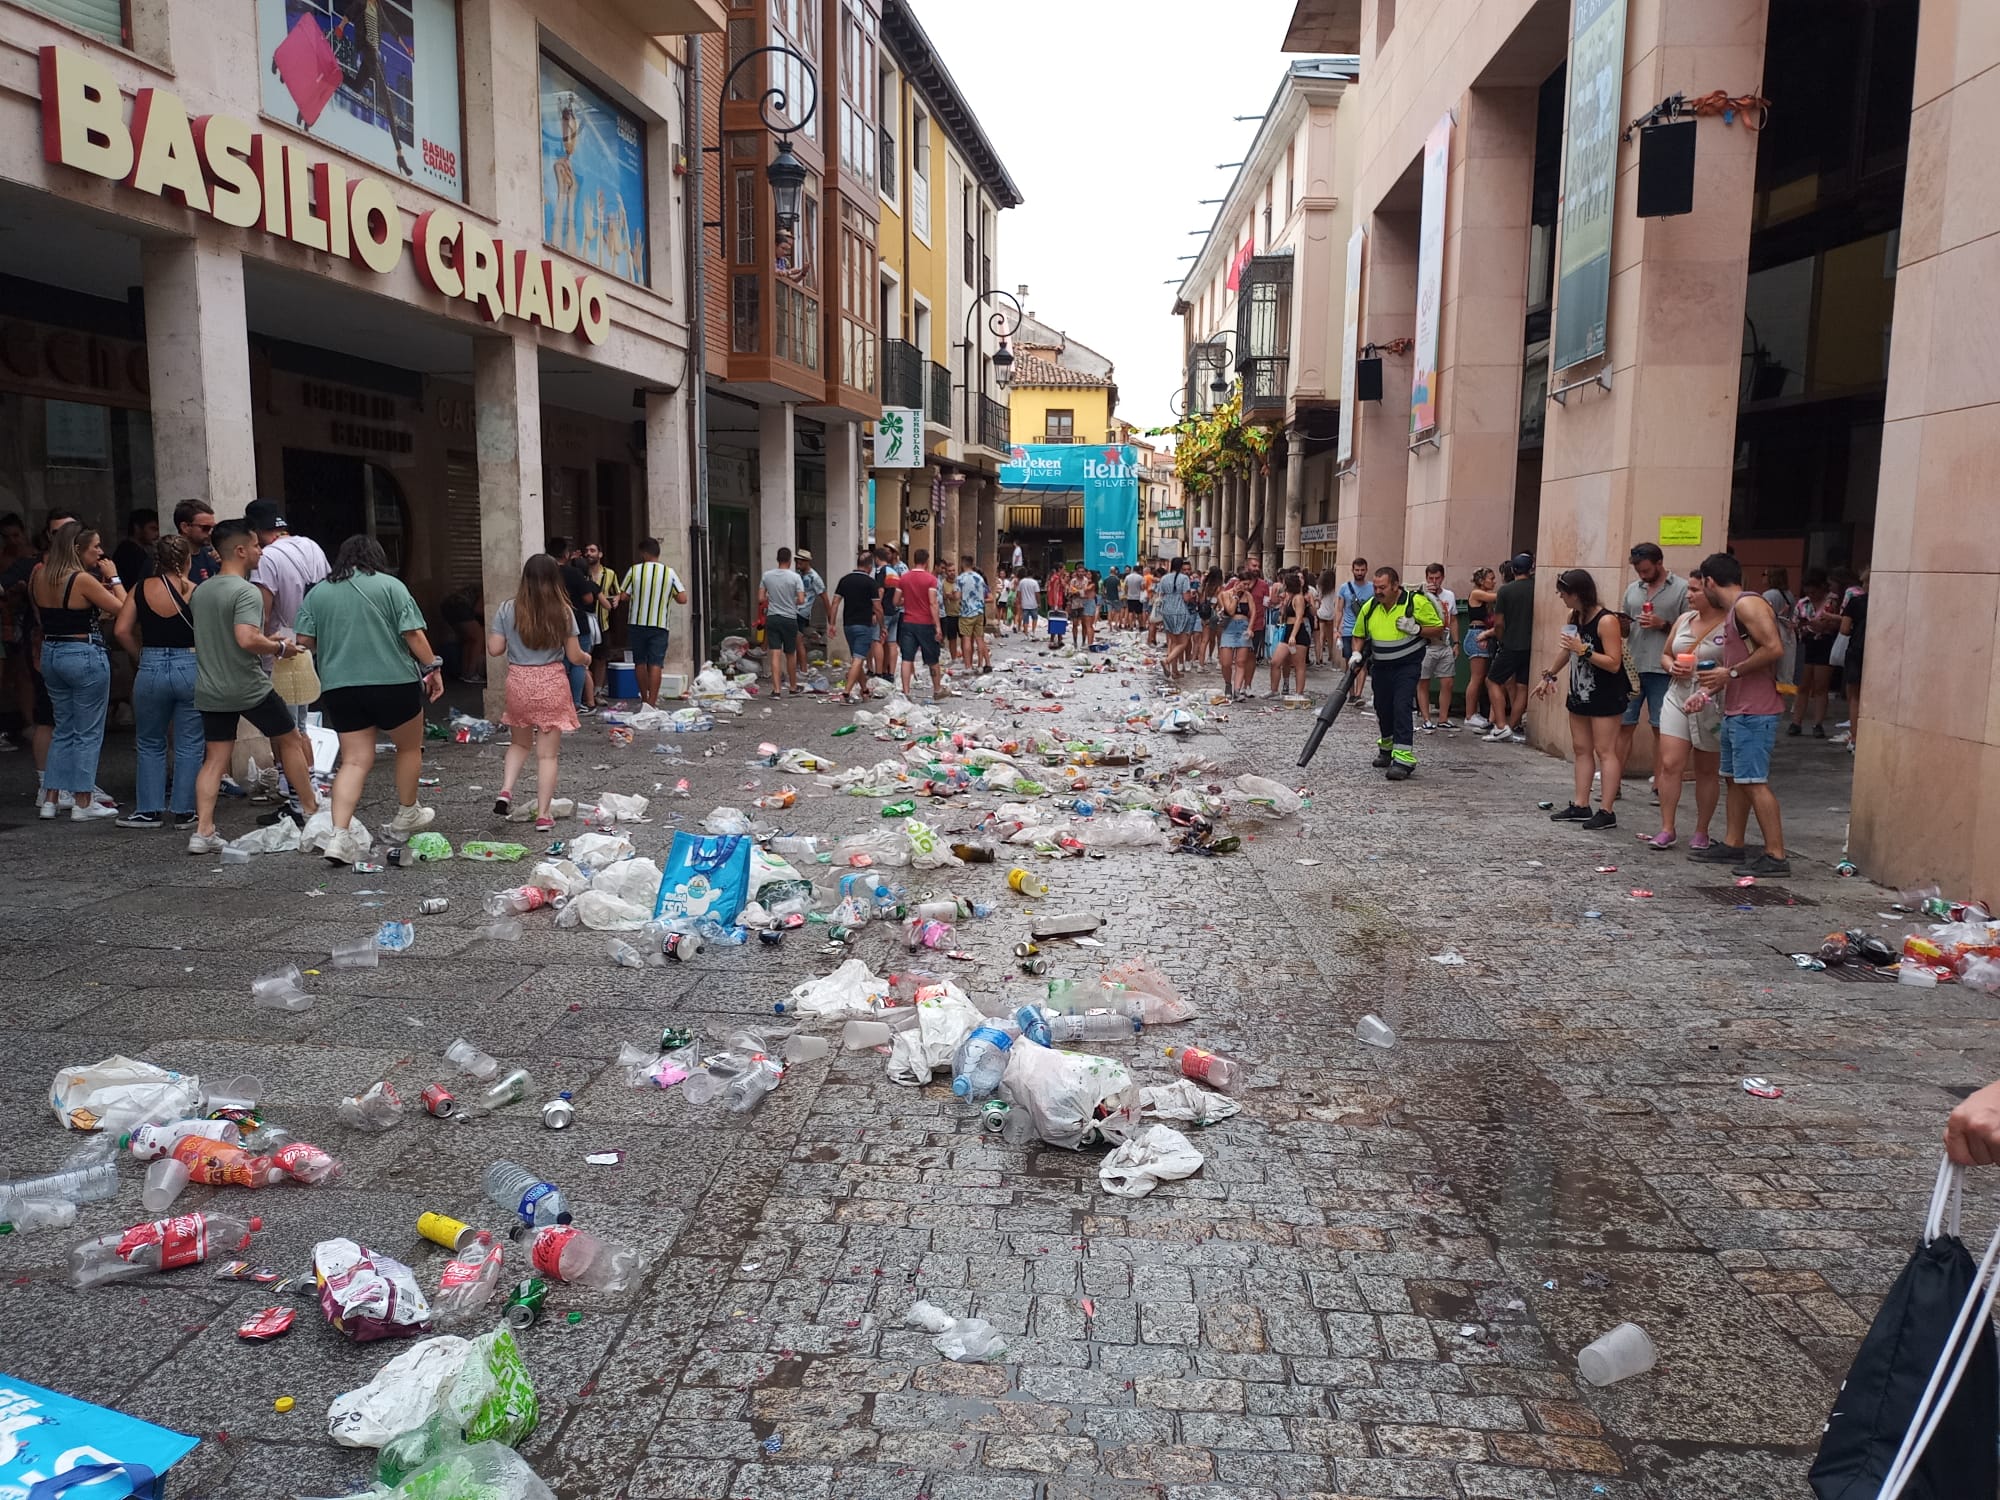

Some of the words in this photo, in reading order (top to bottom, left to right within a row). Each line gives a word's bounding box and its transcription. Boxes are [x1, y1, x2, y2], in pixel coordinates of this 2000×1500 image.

[422, 138, 455, 165] BASILIO
[423, 152, 456, 177] CRIADO
[423, 167, 456, 187] MALETAS
[39, 45, 403, 273] BASILIO
[413, 208, 609, 346] CRIADO
[1022, 469, 1062, 477] SILVER
[1094, 479, 1135, 488] SILVER
